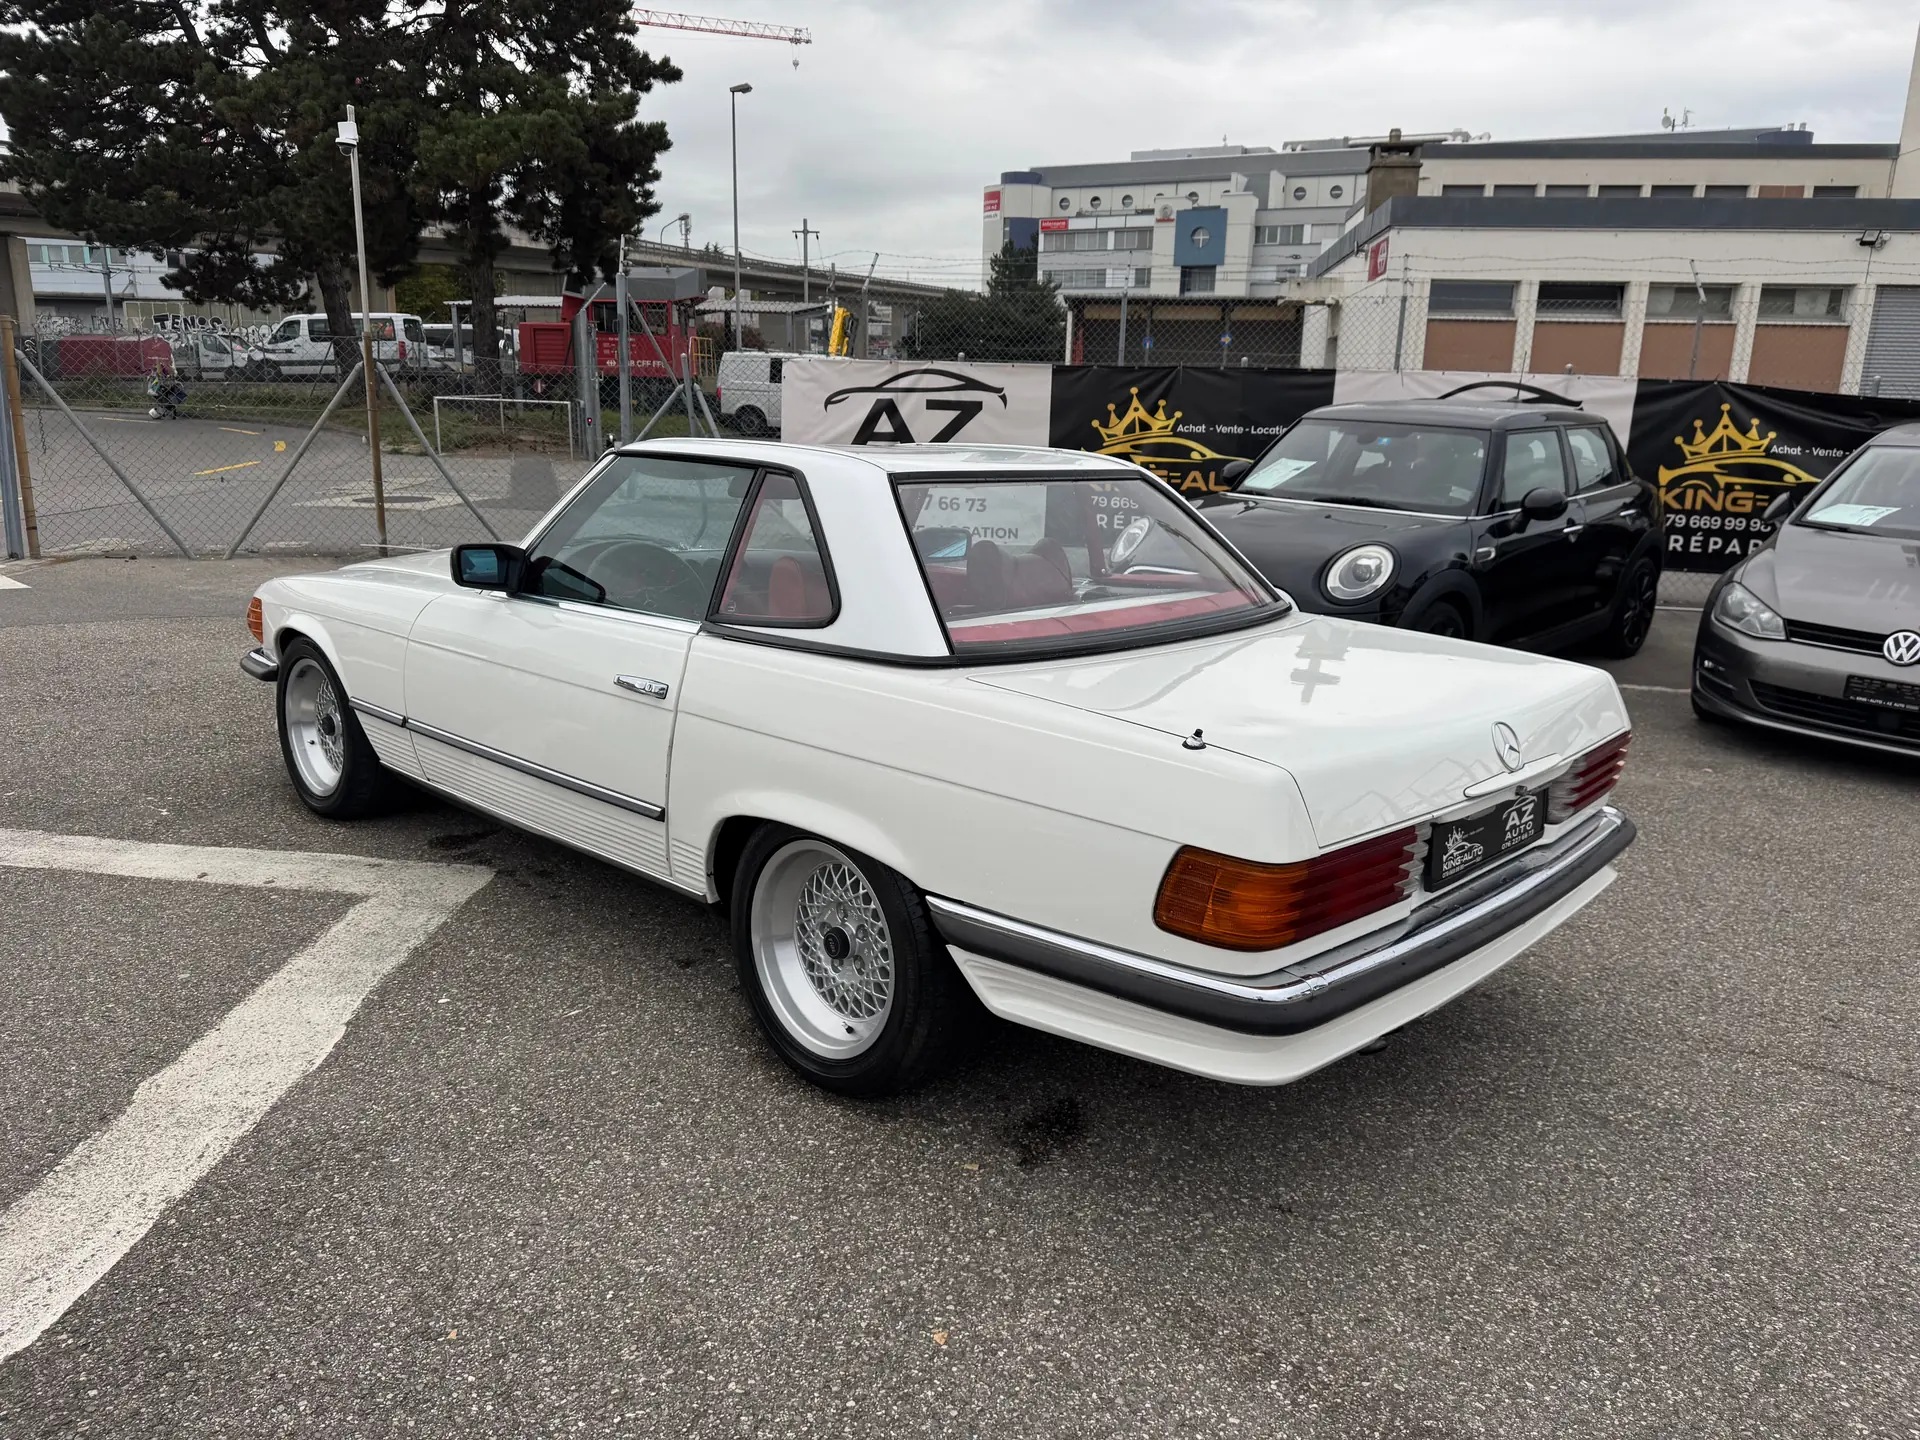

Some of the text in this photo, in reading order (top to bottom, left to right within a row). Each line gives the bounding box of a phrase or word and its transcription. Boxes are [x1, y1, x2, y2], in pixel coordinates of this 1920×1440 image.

[1176, 423, 1206, 433] Achat
[1215, 424, 1244, 434] Vente
[1770, 445, 1802, 455] Achat
[1812, 447, 1844, 457] Vente
[938, 496, 960, 511] 66
[965, 498, 987, 512] 73
[1665, 514, 1687, 528] 79
[1689, 515, 1721, 529] 669
[1724, 517, 1746, 531] 99
[1505, 802, 1534, 831] AZ
[1505, 821, 1533, 841] AUTO
